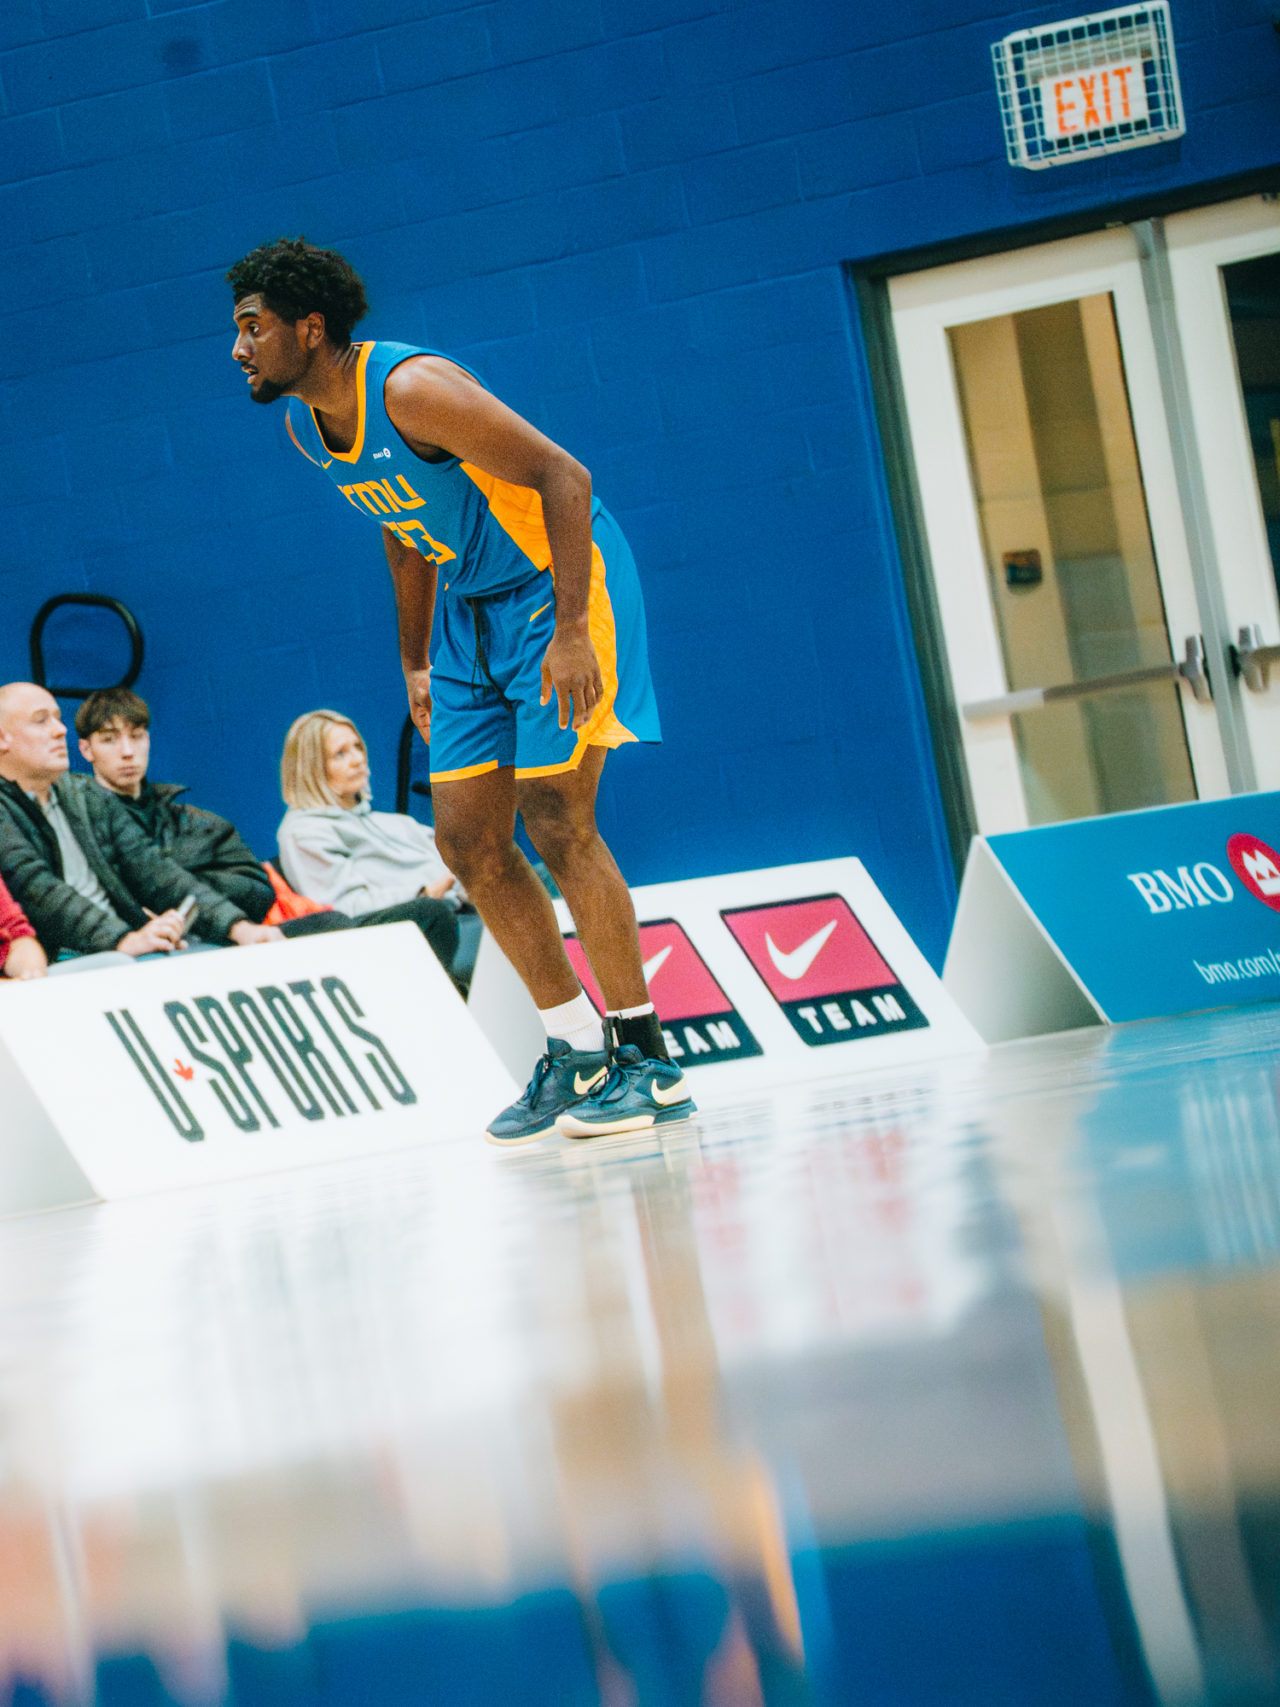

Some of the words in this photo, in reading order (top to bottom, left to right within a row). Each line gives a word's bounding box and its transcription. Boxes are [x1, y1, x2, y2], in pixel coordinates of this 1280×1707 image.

[1054, 66, 1132, 135] EXIT
[1126, 861, 1234, 914] BMO
[663, 1019, 742, 1060] EAM
[796, 992, 907, 1035] TEAM
[102, 1008, 205, 1143] U
[162, 975, 418, 1133] SPORTS
